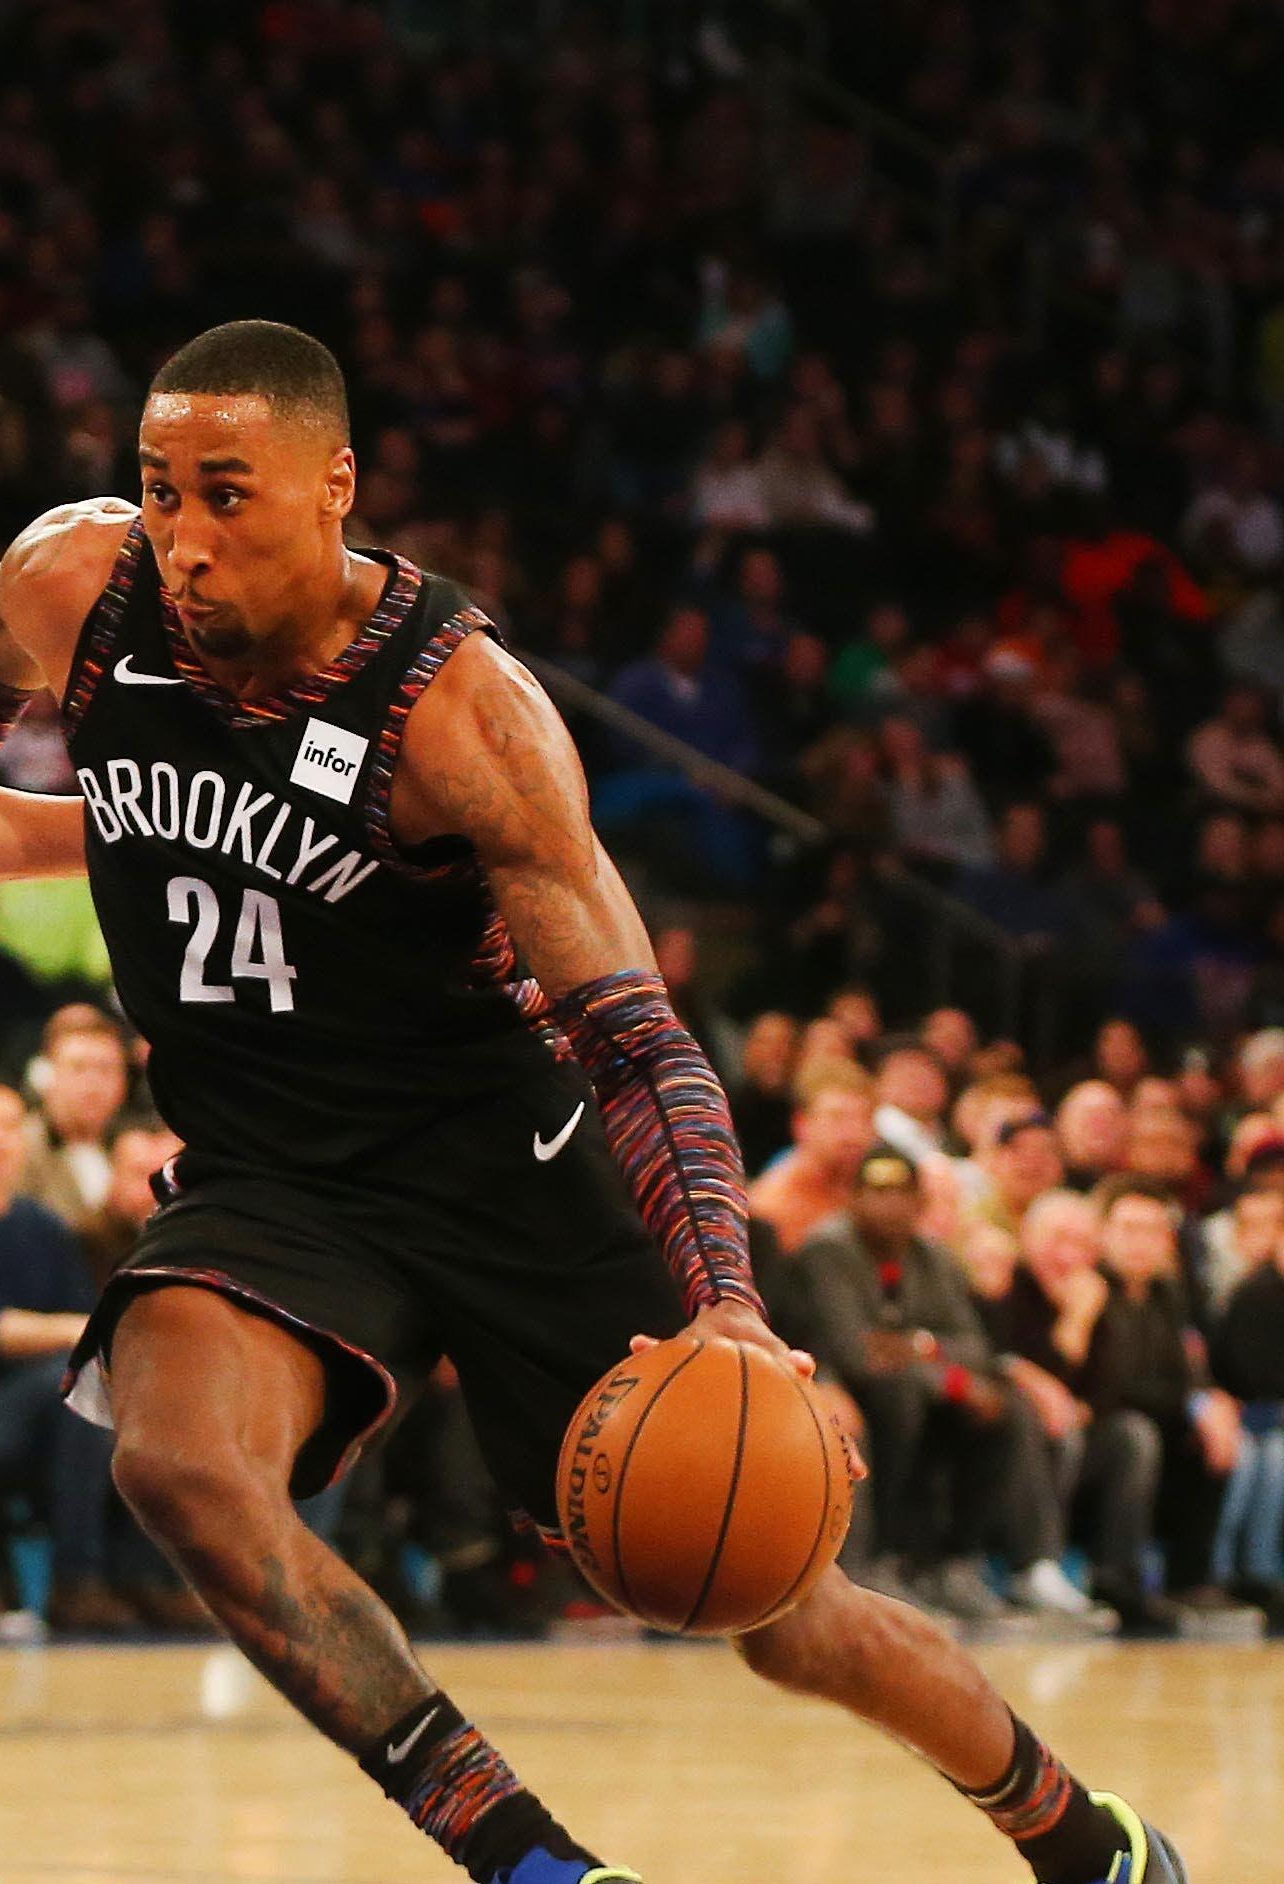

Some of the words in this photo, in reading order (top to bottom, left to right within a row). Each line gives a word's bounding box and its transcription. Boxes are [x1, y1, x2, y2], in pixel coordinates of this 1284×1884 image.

[304, 740, 357, 776] infor
[77, 759, 380, 903] BROOKLYN
[167, 876, 298, 1012] 24
